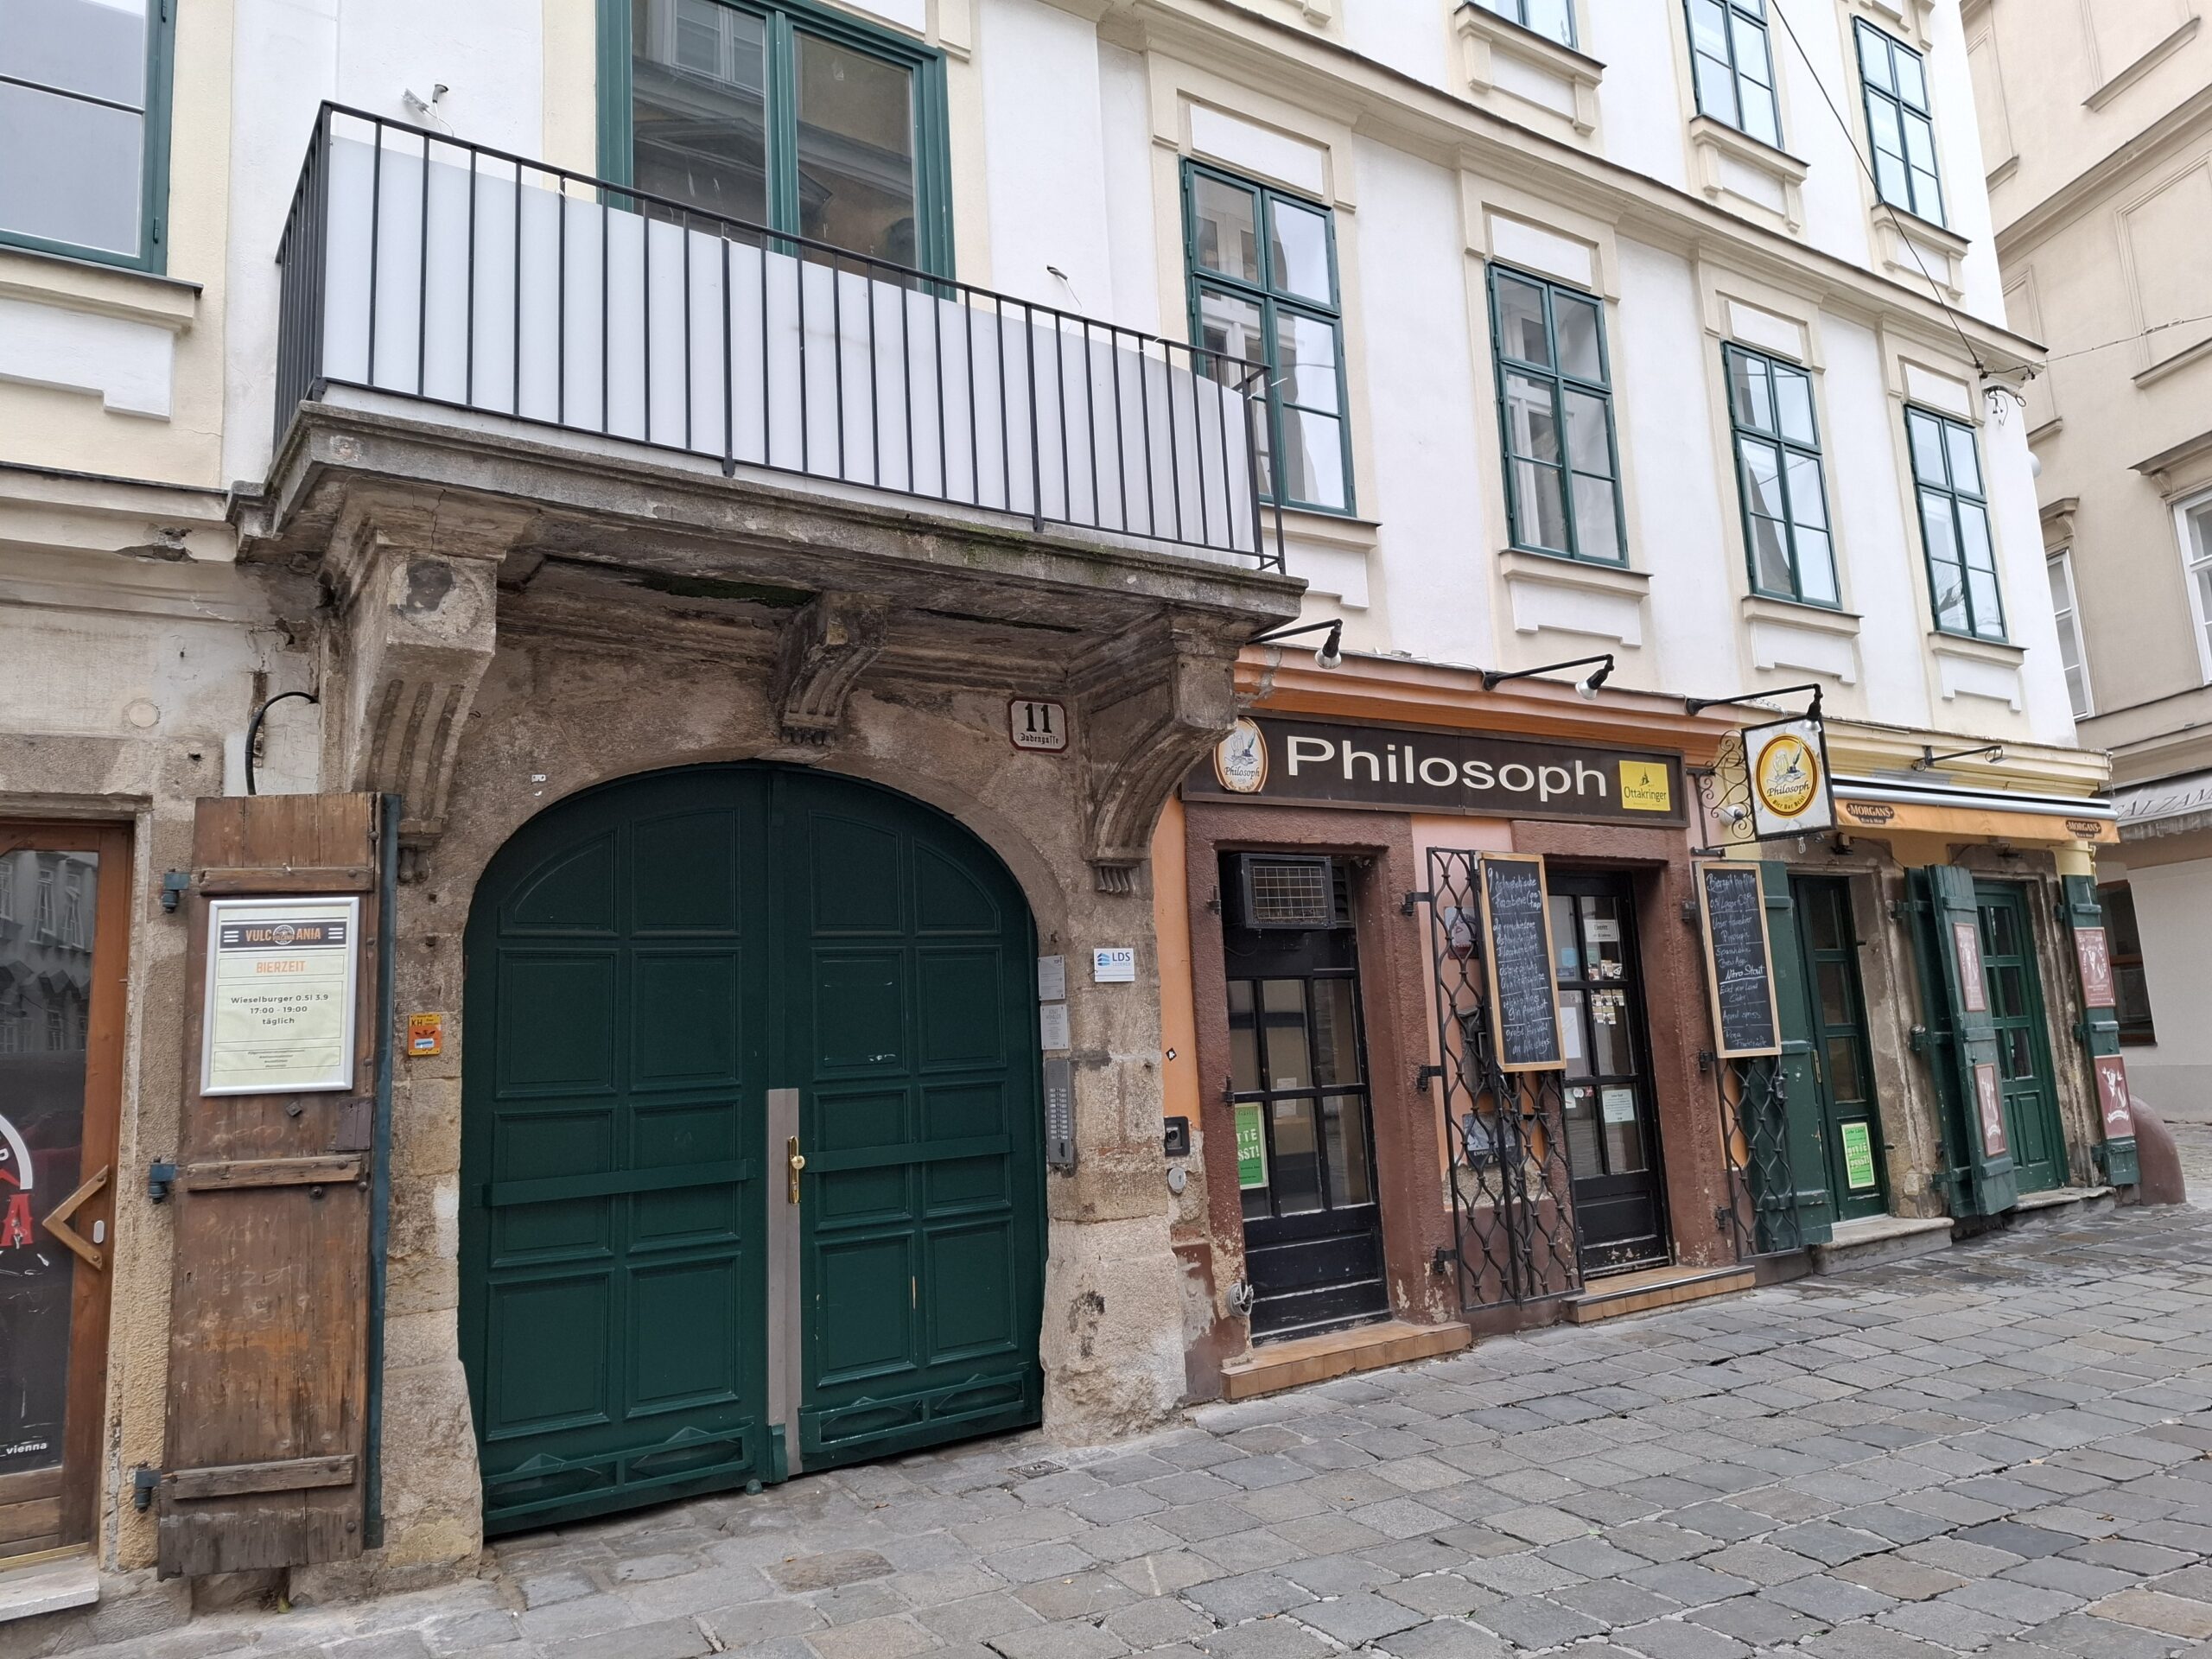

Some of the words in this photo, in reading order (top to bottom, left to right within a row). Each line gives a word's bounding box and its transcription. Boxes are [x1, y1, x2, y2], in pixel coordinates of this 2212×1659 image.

[1025, 703, 1052, 734] 11
[1224, 766, 1261, 780] Philosoph
[1287, 735, 1607, 803] Philosoph
[1624, 785, 1667, 803] Ottakringer
[1766, 779, 1811, 797] Philosoph
[1849, 804, 1891, 817] MORGANS
[2068, 821, 2099, 832] MORGANS
[1112, 951, 1131, 962] LDS
[256, 960, 306, 974] BIERZEIT
[1726, 969, 1744, 981] Nitro
[1744, 964, 1765, 976] Stout
[262, 1017, 295, 1026] täglich
